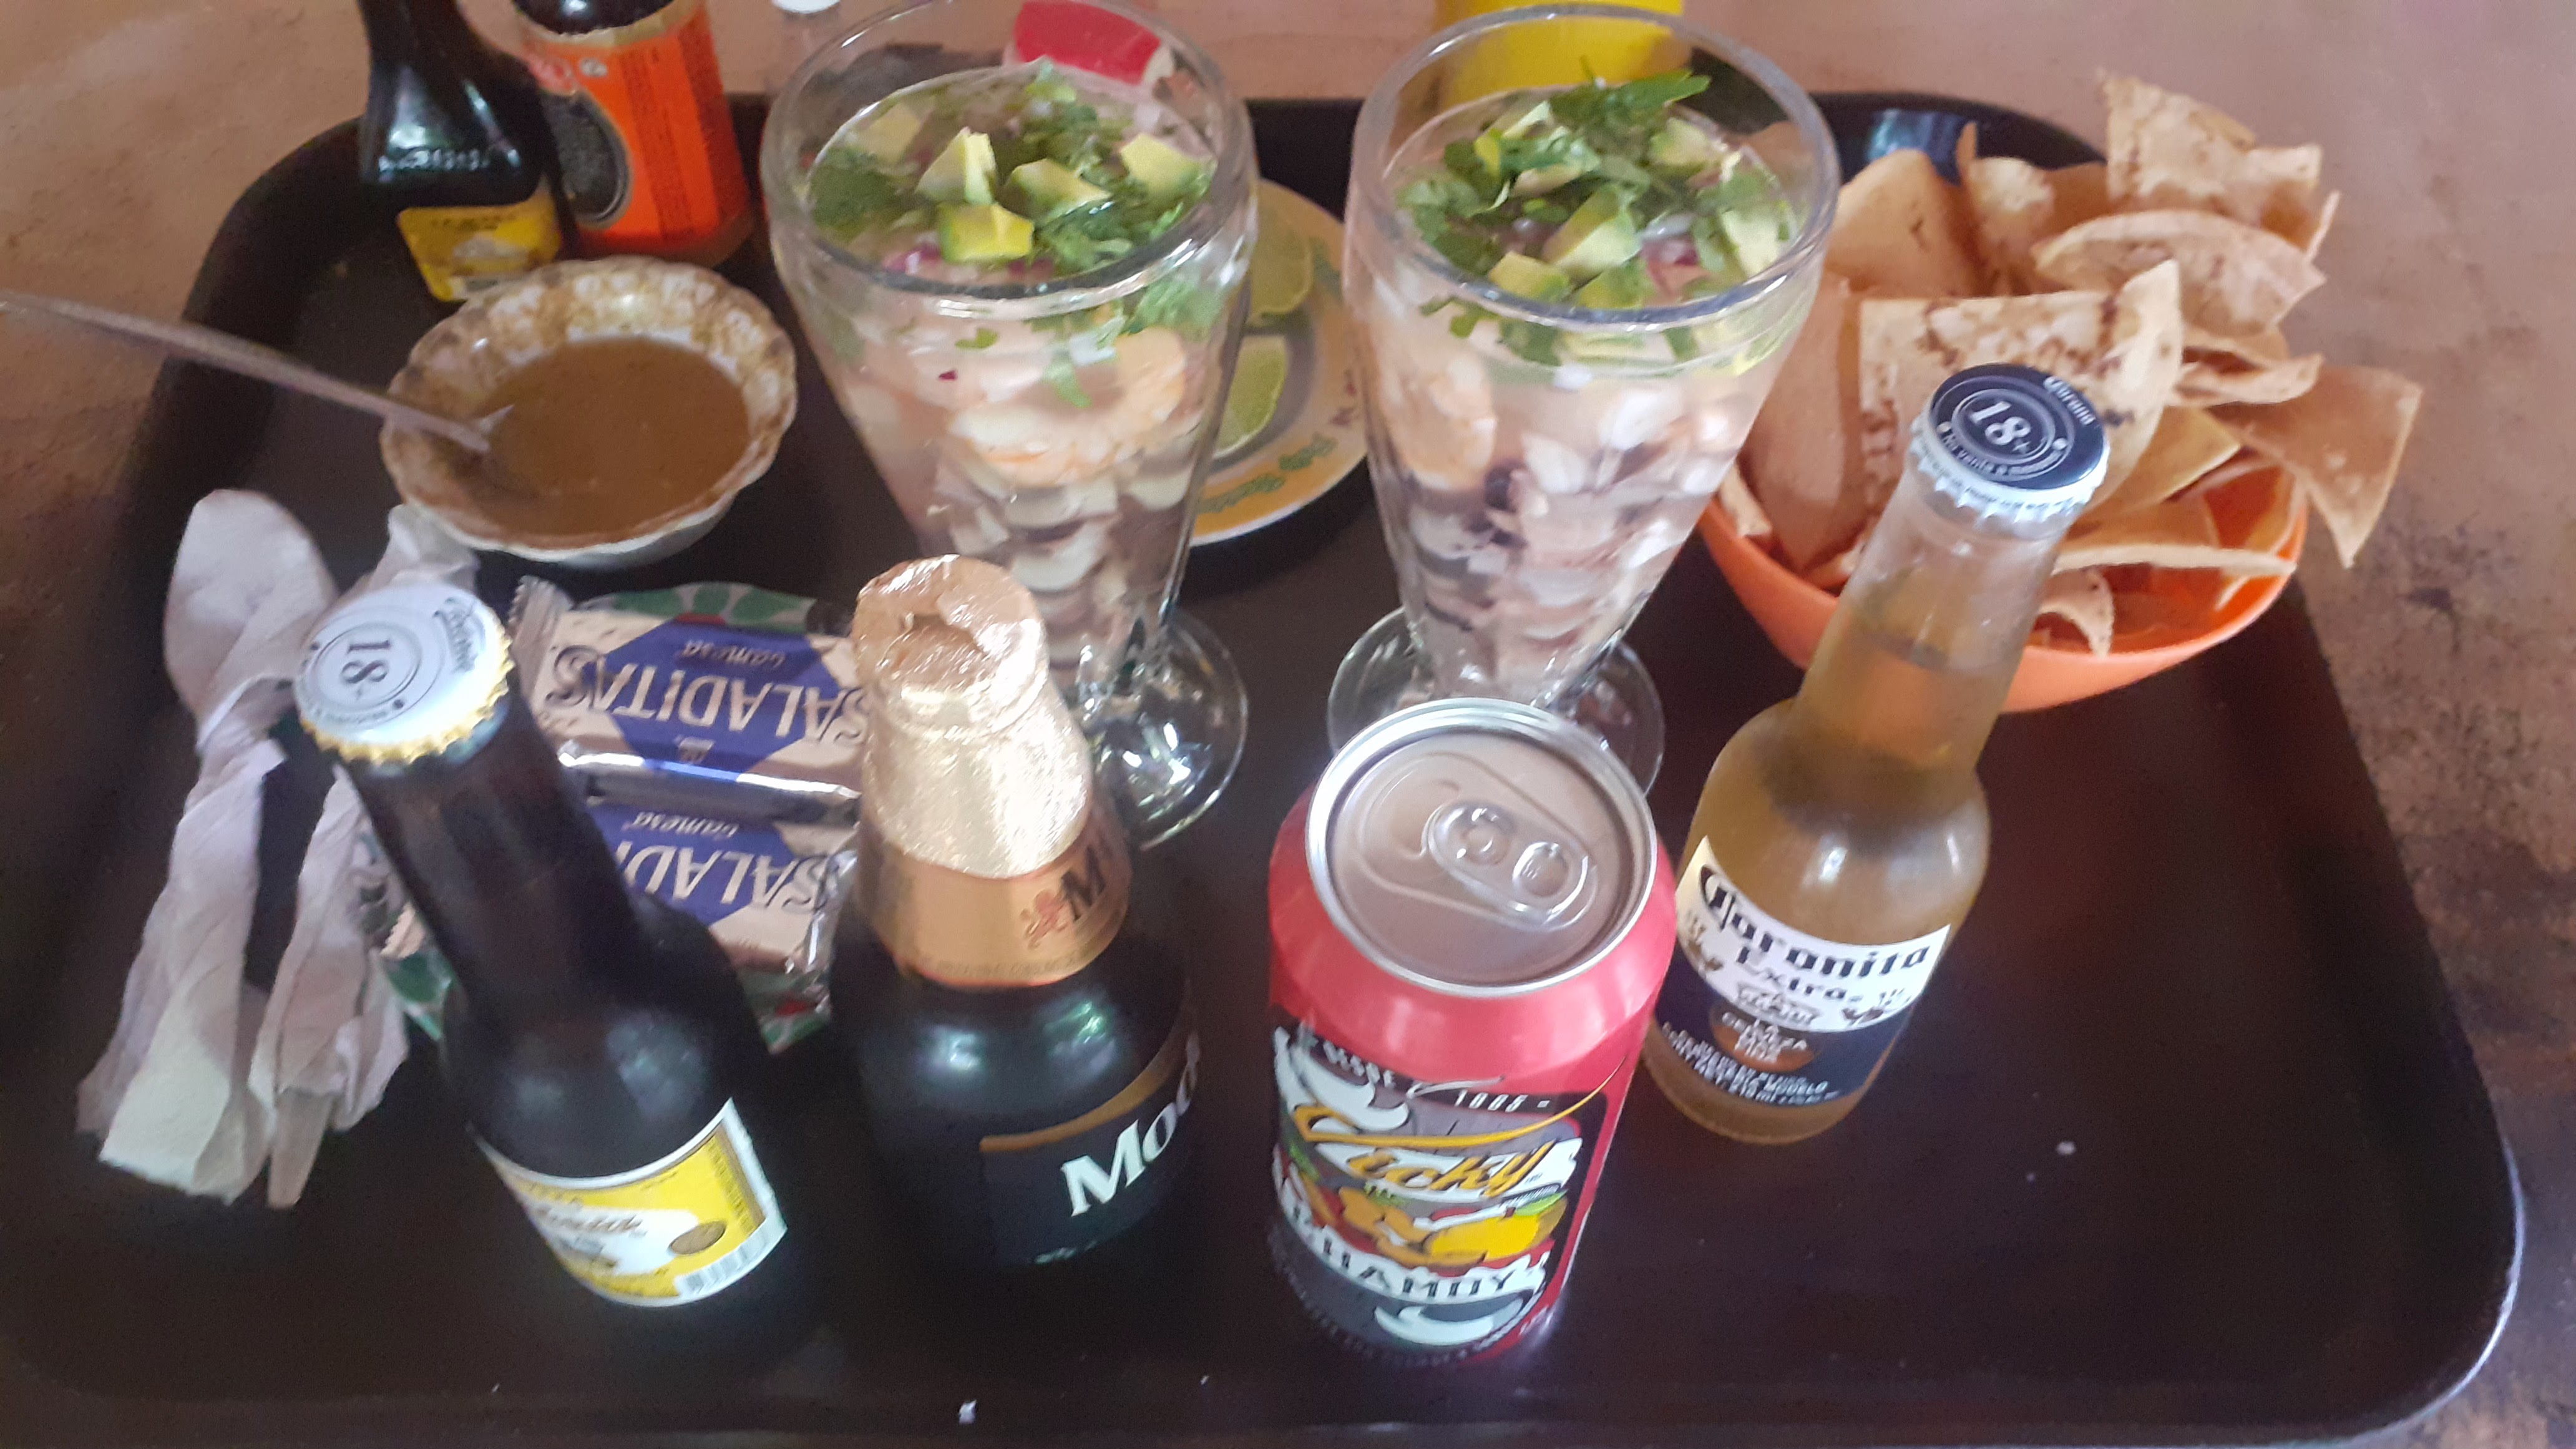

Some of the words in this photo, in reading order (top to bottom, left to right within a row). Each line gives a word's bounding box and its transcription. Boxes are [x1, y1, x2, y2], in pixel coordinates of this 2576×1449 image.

[1969, 401, 2031, 455] 18+
[341, 639, 392, 701] 18+
[545, 644, 869, 745] SALADITAS
[1699, 862, 1931, 978] Coronita
